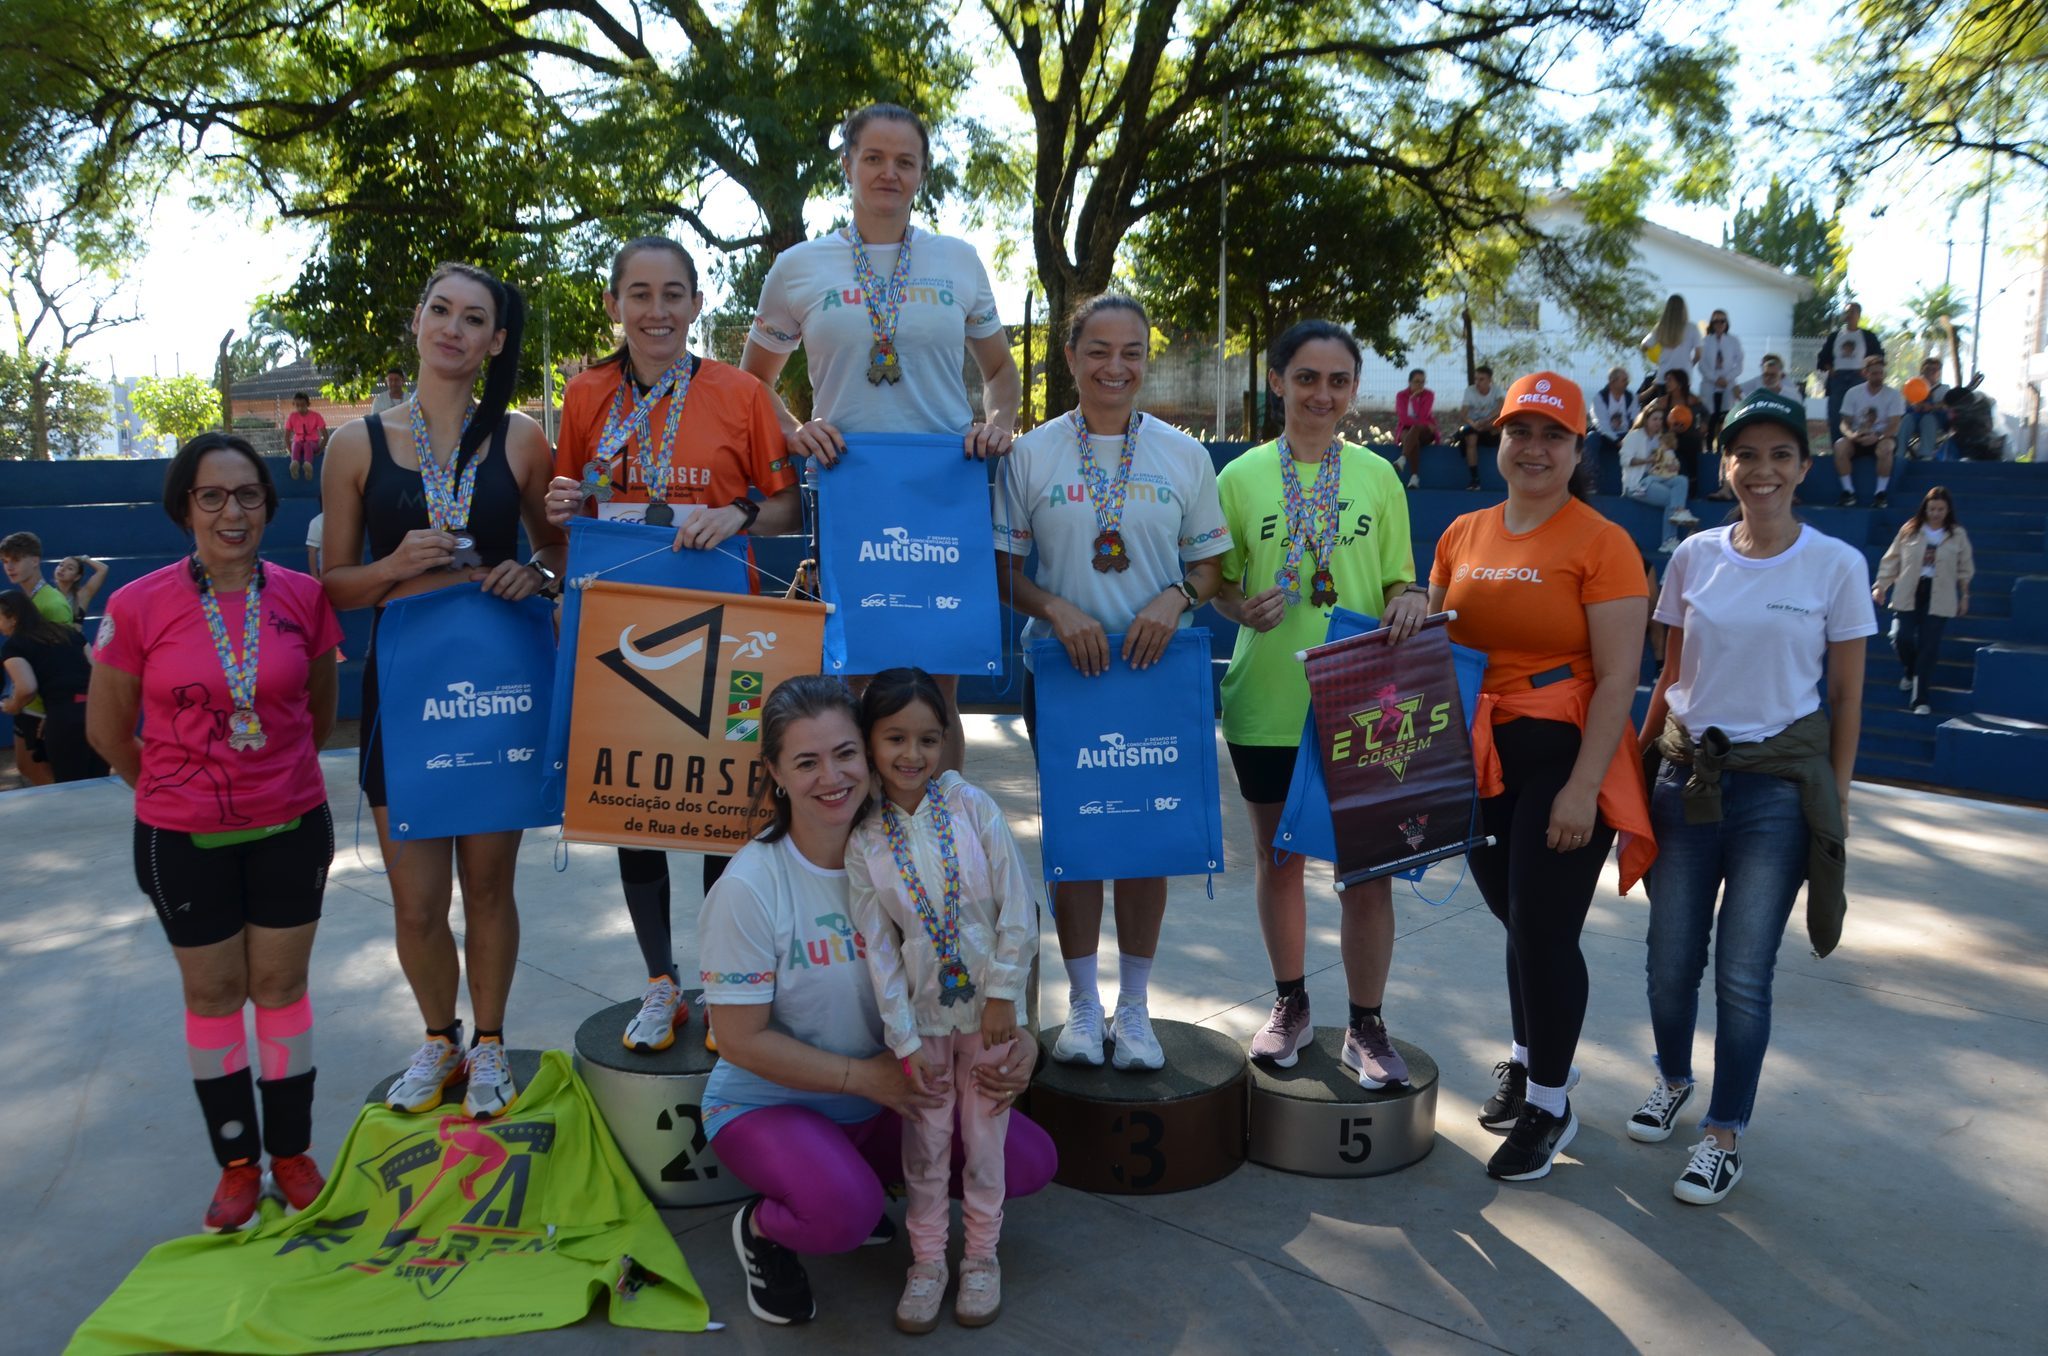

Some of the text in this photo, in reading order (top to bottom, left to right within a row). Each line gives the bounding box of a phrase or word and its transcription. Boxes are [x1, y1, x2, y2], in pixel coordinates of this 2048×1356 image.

[1516, 393, 1565, 409] CRESOL
[1050, 483, 1172, 508] Aumo
[858, 541, 960, 564] Autismo
[1471, 567, 1543, 583] CRESOL
[422, 694, 533, 721] Autismo
[1332, 701, 1450, 761] ELAS
[1076, 746, 1179, 769] Autismo
[1357, 735, 1433, 768] CORREM
[588, 790, 774, 818] Associação dos Corredor
[624, 817, 750, 840] de Rua de Seber
[788, 931, 867, 970] Autis
[656, 1104, 718, 1182] 2
[1111, 1110, 1167, 1188] 3
[1338, 1117, 1373, 1164] 5
